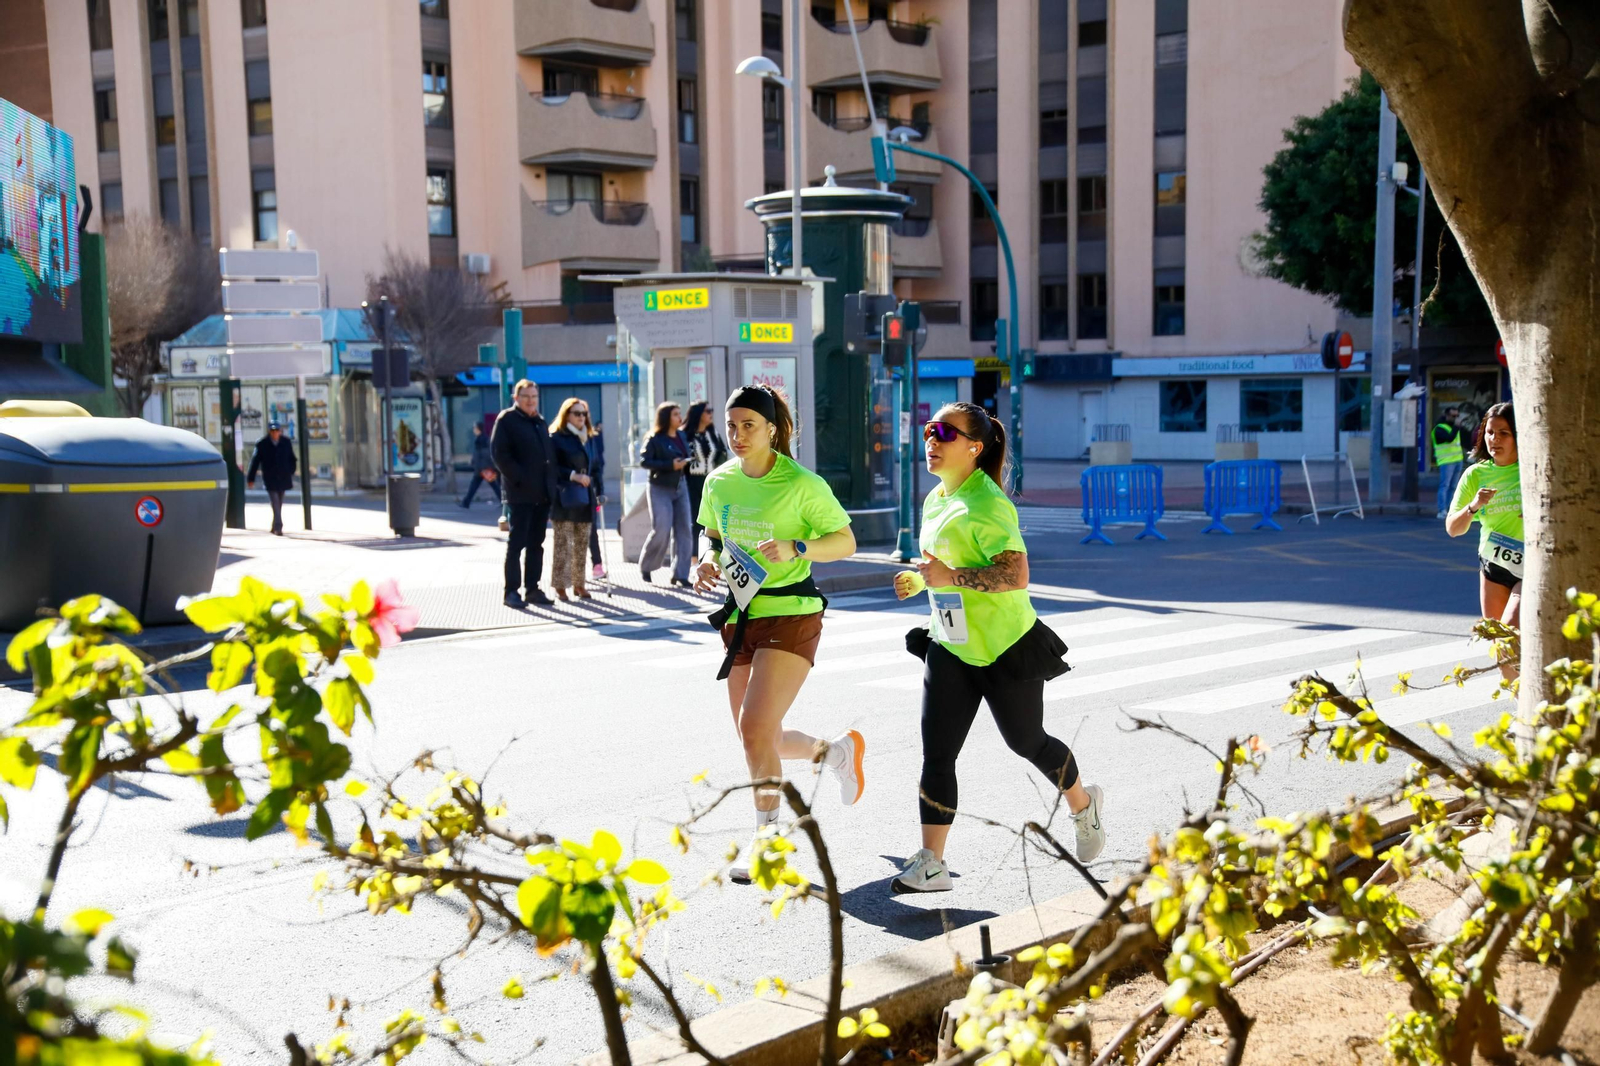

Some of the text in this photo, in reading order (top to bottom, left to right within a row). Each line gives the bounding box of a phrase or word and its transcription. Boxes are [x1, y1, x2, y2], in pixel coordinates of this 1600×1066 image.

[663, 292, 703, 306] ONCE
[755, 327, 788, 339] ONCE
[1178, 360, 1254, 372] traditional food
[1487, 503, 1521, 515] cánce
[729, 516, 775, 530] En marcha
[729, 527, 774, 540] contra el
[725, 555, 750, 589] 759
